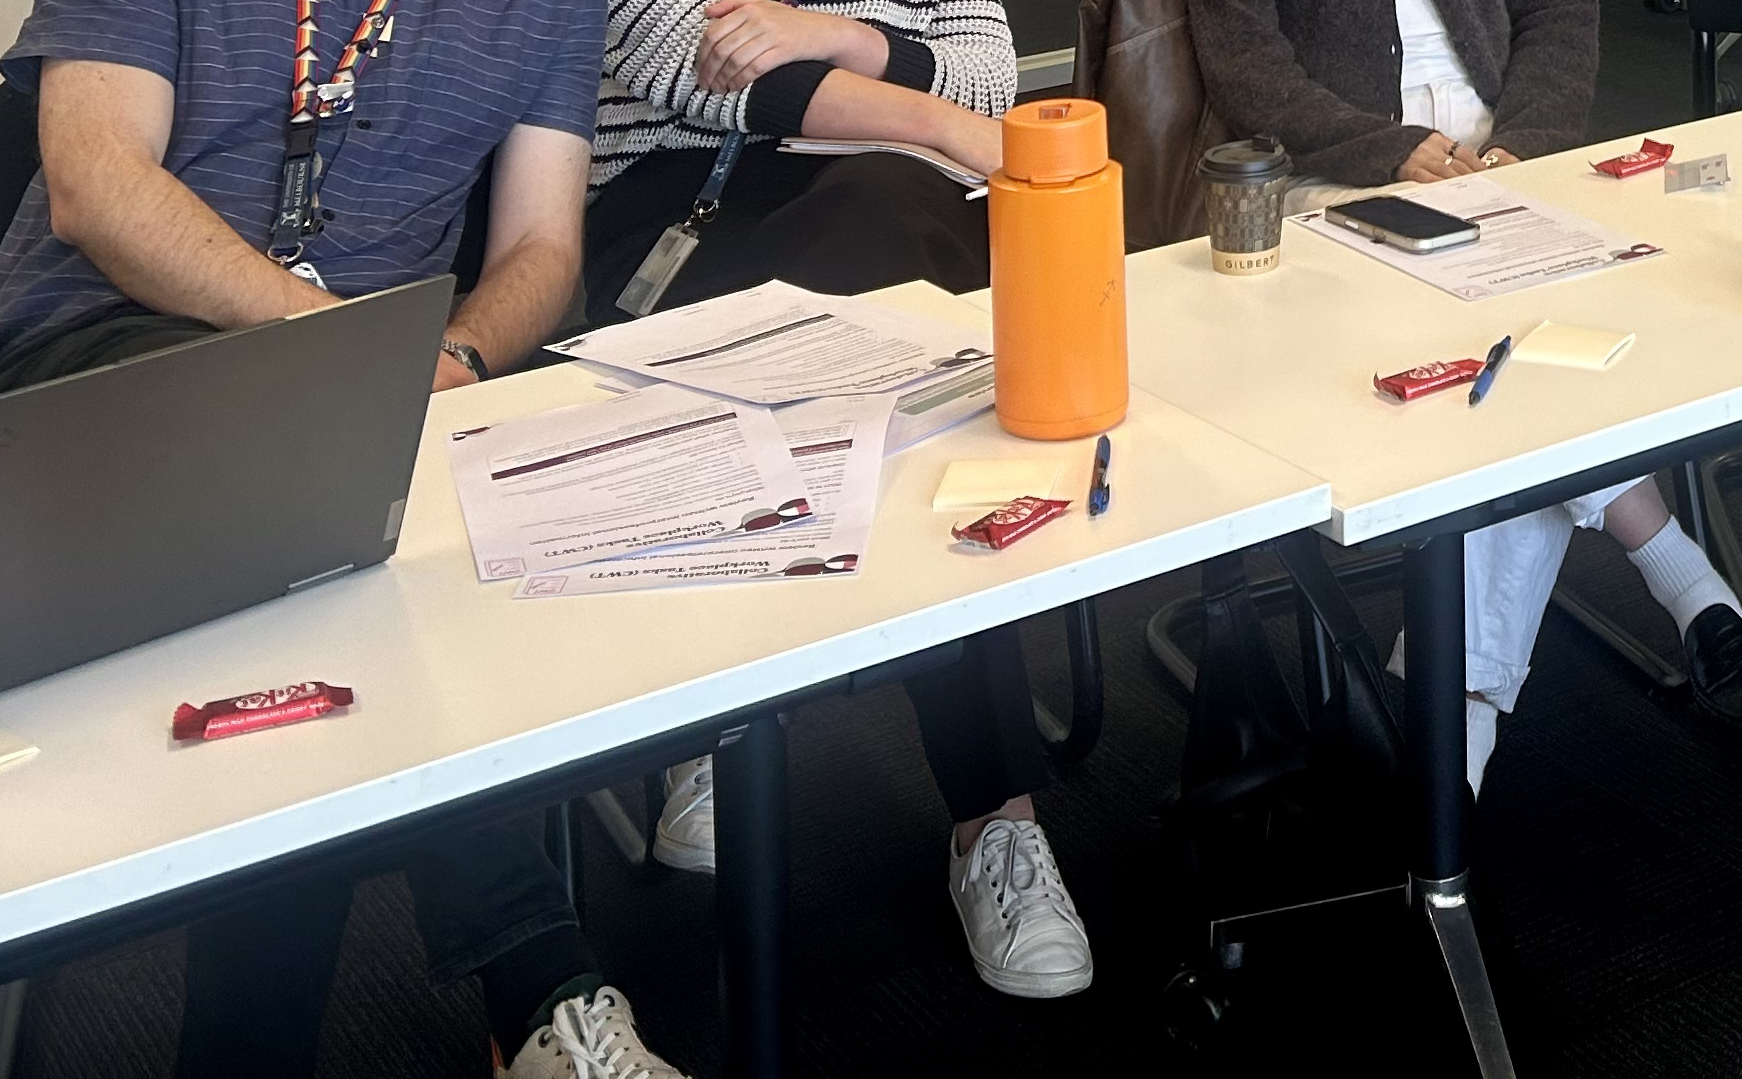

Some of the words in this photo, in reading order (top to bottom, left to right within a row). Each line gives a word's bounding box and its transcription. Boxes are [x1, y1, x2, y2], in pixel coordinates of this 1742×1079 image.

[293, 162, 306, 207] MELBOURNE
[1225, 254, 1275, 270] GILBERT
[642, 521, 723, 540] Workplace
[596, 537, 642, 549] Tasks
[625, 526, 725, 549] Collaborative
[544, 544, 595, 558] (CWT)
[642, 567, 687, 575] Tasks
[689, 561, 771, 572] Workplace
[588, 569, 639, 580] (CWT)
[667, 568, 770, 580] Collaborative
